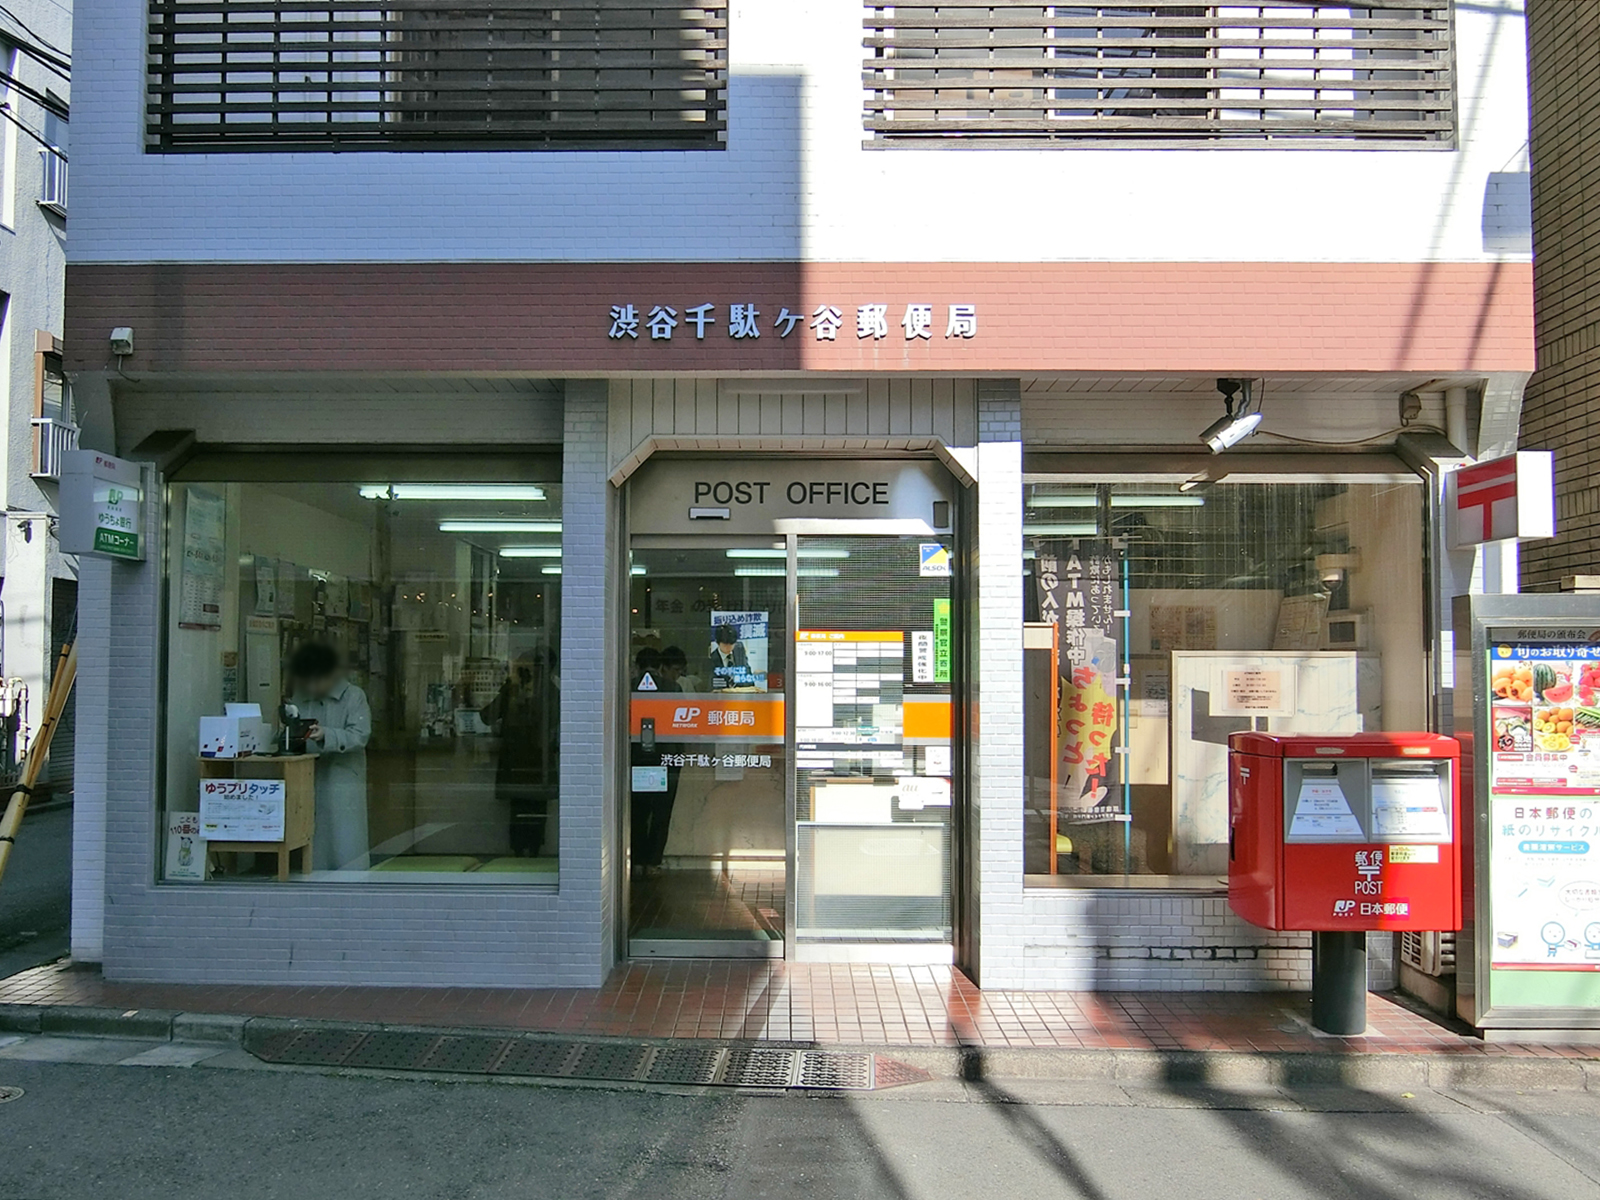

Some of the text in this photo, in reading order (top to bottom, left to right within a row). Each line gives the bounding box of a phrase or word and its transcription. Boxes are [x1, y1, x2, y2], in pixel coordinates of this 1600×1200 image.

[694, 481, 890, 505] POST OFFICE
[98, 513, 132, 529] ゆうちょ銀行
[99, 532, 135, 547] ATMコーナー
[1517, 629, 1586, 640] 郵便局の頒布会
[673, 707, 701, 722] JP
[707, 710, 755, 726] 郵便局
[660, 753, 772, 768] 渋谷千駄ヶ谷郵便局
[205, 782, 280, 795] ゆうプリタッチ
[1514, 807, 1593, 820] 日本郵便の
[1355, 850, 1383, 867] 郵便
[1354, 880, 1384, 895] POST
[1333, 900, 1356, 913] JP
[1360, 902, 1409, 916] 日本郵便
